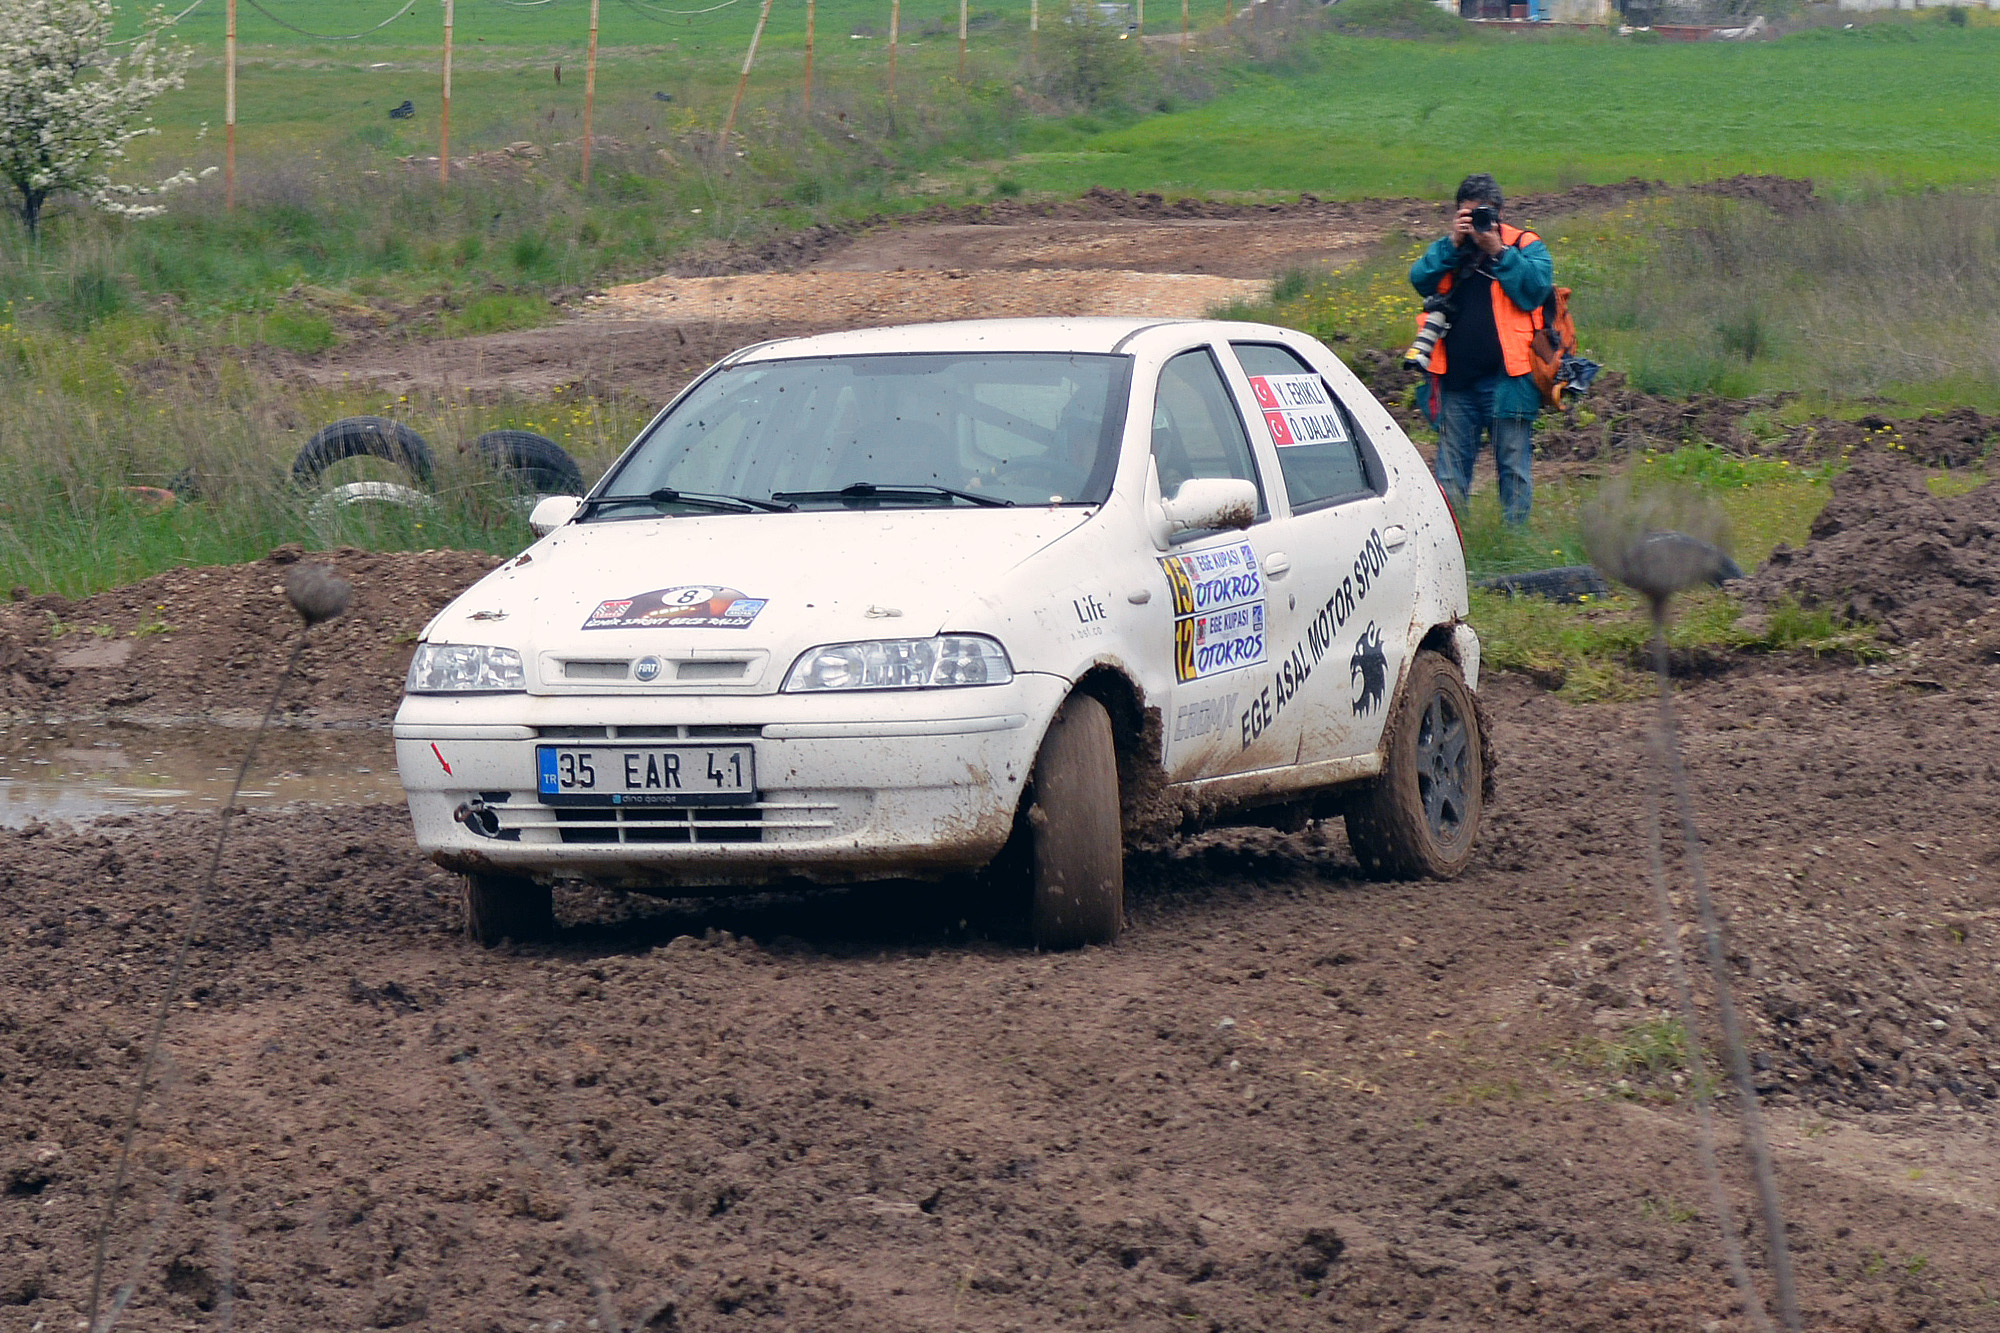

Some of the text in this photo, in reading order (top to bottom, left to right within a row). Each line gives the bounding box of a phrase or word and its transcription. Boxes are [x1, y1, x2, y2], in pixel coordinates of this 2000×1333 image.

[1301, 414, 1342, 441] DALAN
[1196, 555, 1214, 572] EGE
[1212, 549, 1241, 568] KUPASI
[677, 589, 700, 604] 8
[1161, 556, 1194, 614] 15
[1196, 571, 1260, 607] OTOKROS
[1209, 615, 1223, 634] EGE
[1223, 608, 1249, 630] KUPASI
[1175, 618, 1197, 682] 12
[1197, 633, 1264, 673] OTOKROS
[1240, 527, 1390, 752] EGE ASAL MOTOR SPOR
[638, 663, 657, 673] FIAT
[543, 752, 742, 789] TR 35 EAR 41
[622, 794, 677, 804] dino garage
